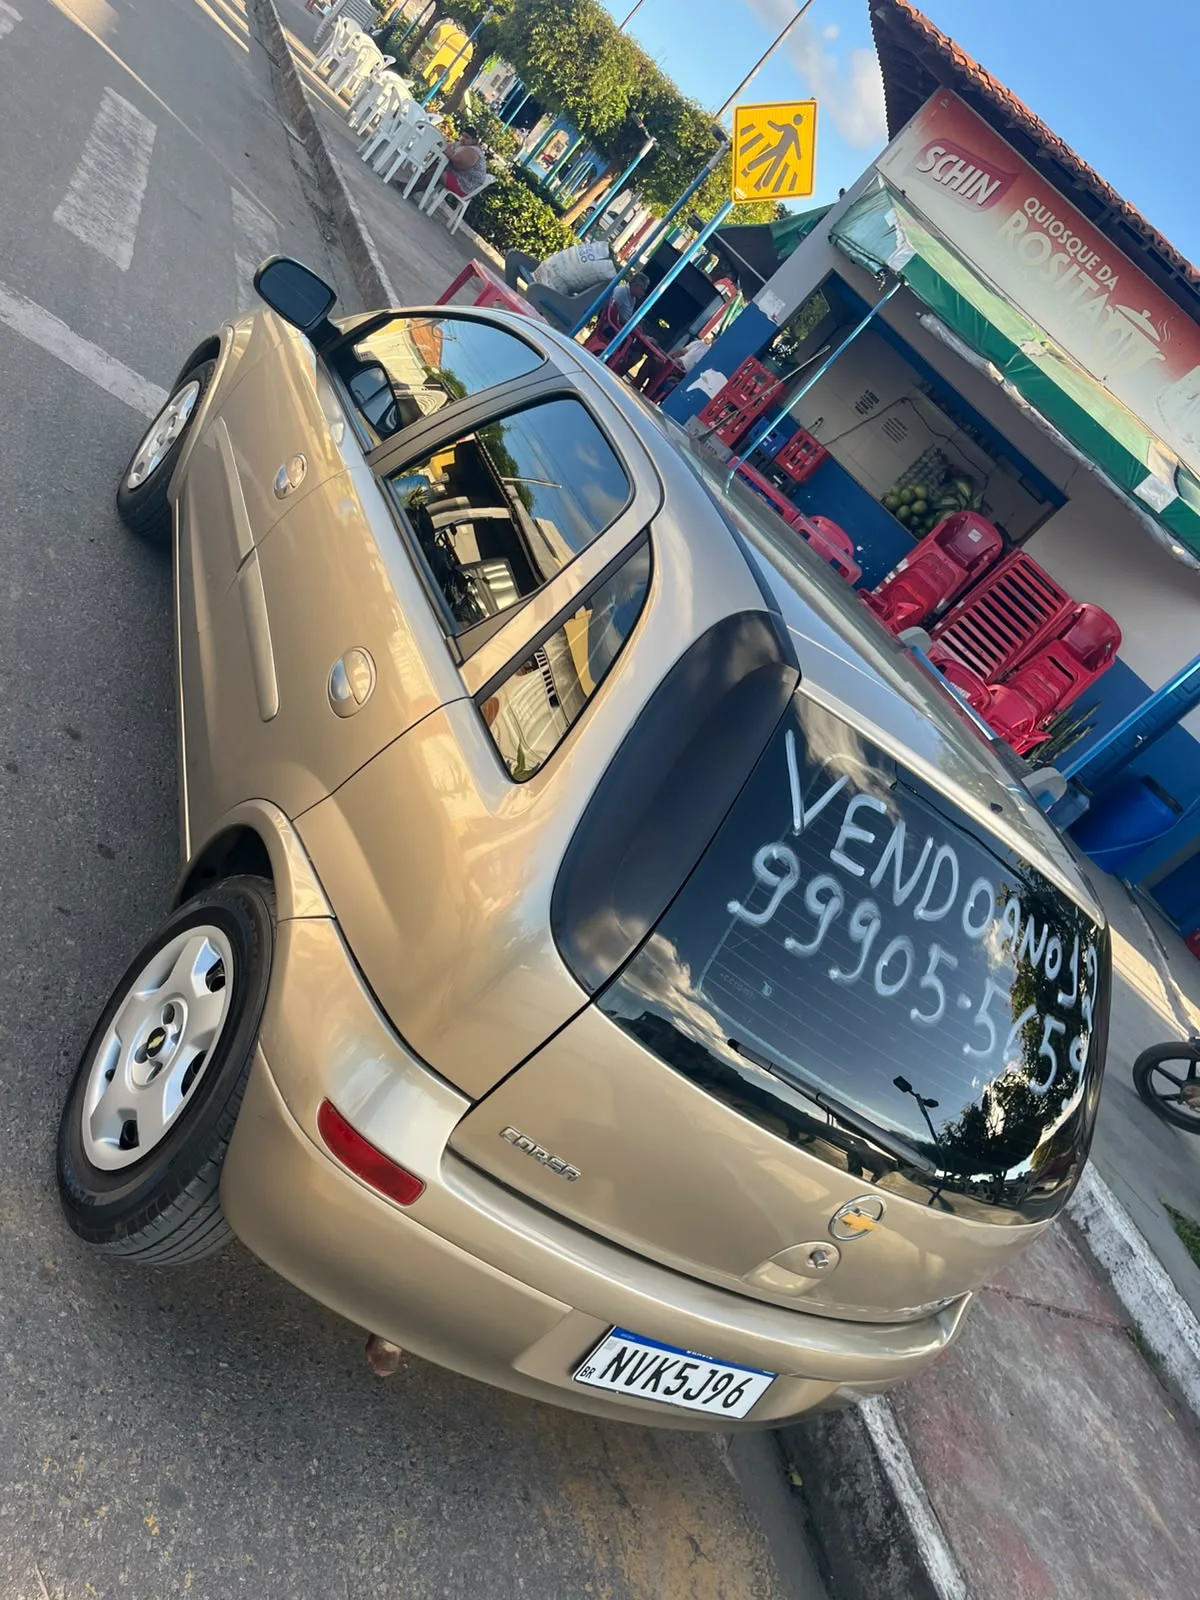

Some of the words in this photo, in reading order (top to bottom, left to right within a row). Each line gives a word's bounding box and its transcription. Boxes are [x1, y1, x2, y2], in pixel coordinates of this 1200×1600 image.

[916, 146, 1001, 206] SCHIN
[1000, 209, 1110, 328] ROSITA
[1024, 197, 1102, 269] QUIOSQUE
[1095, 264, 1120, 292] DA
[785, 729, 995, 939] VENDO
[499, 1125, 582, 1182] CORSA
[580, 1365, 596, 1379] BR
[600, 1346, 754, 1409] NVK5J96
